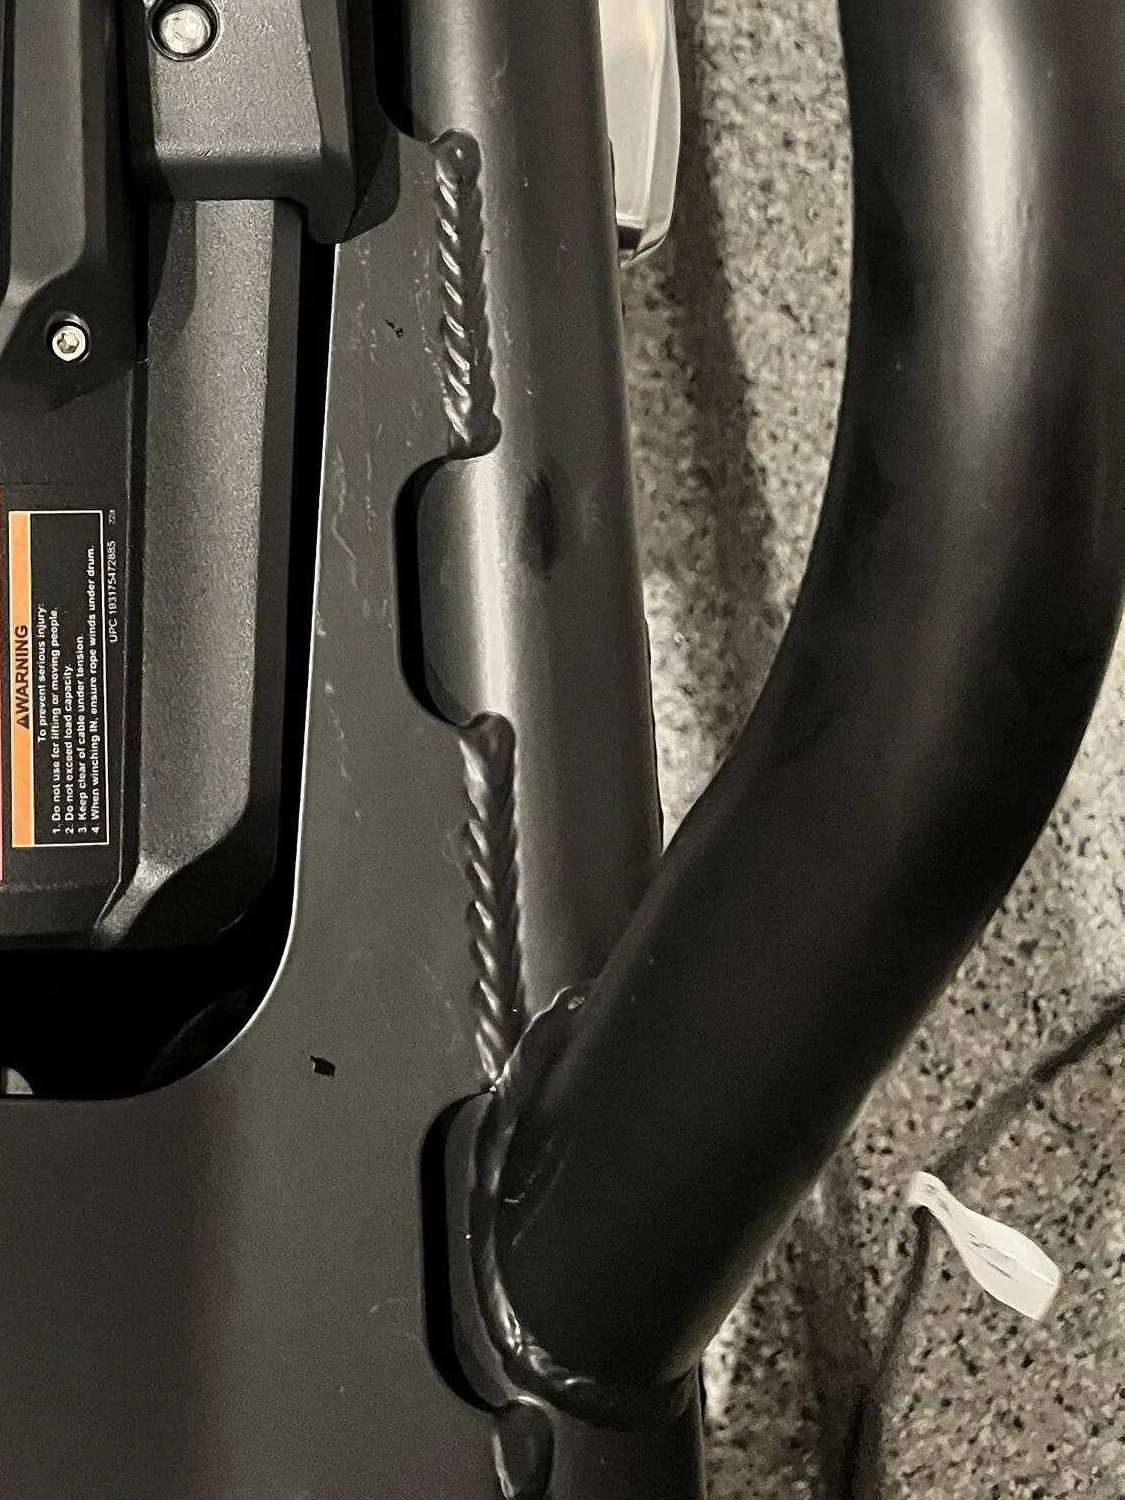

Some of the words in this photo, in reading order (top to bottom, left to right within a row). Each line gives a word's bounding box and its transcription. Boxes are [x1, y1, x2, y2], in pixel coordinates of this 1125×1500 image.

[87, 547, 95, 576] drum.
[88, 614, 96, 646] winds
[109, 618, 118, 643] UPC
[15, 625, 29, 714] WARNING
[37, 641, 45, 682] serious
[50, 650, 60, 690] moving
[90, 650, 98, 673] rope
[52, 693, 59, 704] or
[64, 664, 73, 711] capacity.
[37, 684, 47, 726] prevent
[37, 729, 46, 742] To
[51, 708, 61, 739] lifting
[77, 715, 85, 744] cable
[91, 718, 99, 732] IN,
[51, 742, 60, 758] for
[65, 742, 73, 781] exceed
[78, 748, 85, 759] of
[90, 735, 100, 785] winching
[78, 762, 86, 788] clear
[52, 784, 60, 802] not
[66, 784, 74, 801] not
[78, 792, 88, 820] Keep
[91, 789, 99, 820] When
[52, 805, 61, 820] Do
[65, 805, 74, 820] Do
